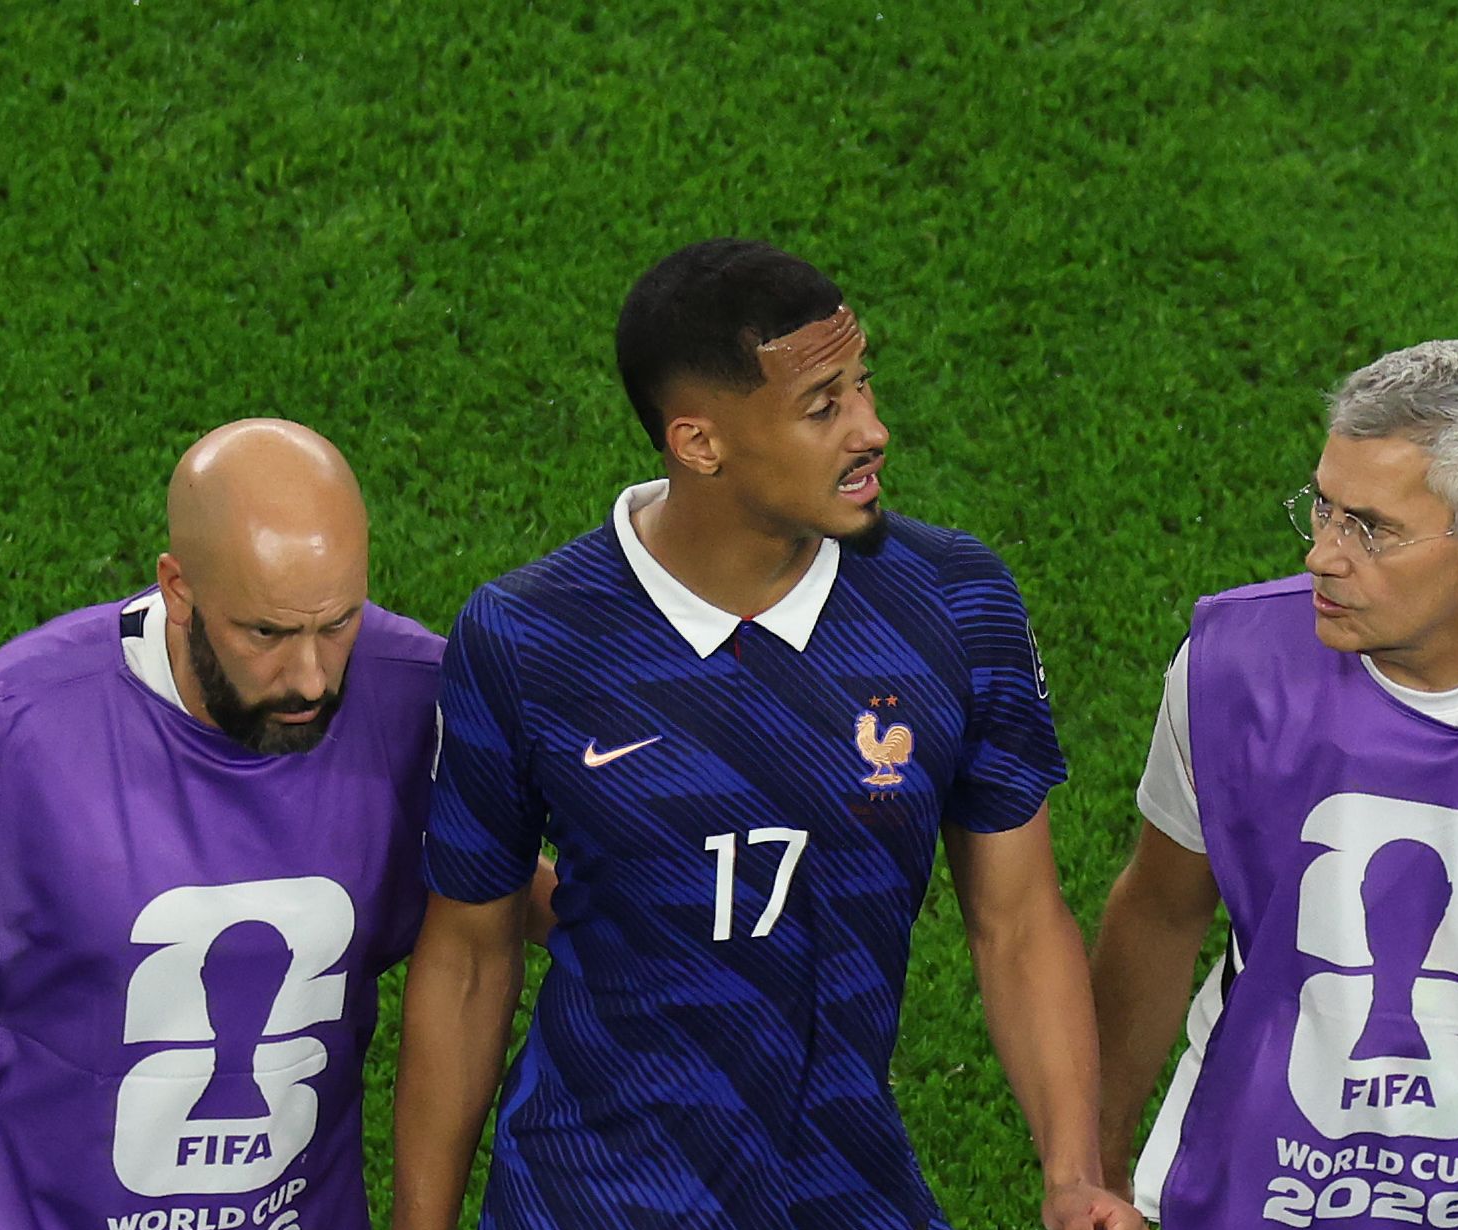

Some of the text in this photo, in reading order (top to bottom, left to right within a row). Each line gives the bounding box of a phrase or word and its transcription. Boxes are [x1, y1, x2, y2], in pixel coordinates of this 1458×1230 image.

[704, 827, 809, 942] 17
[1340, 1073, 1436, 1110] FIFA
[176, 1132, 272, 1168] FIFA
[1276, 1137, 1405, 1180] WORLD
[252, 1177, 307, 1225] CUP
